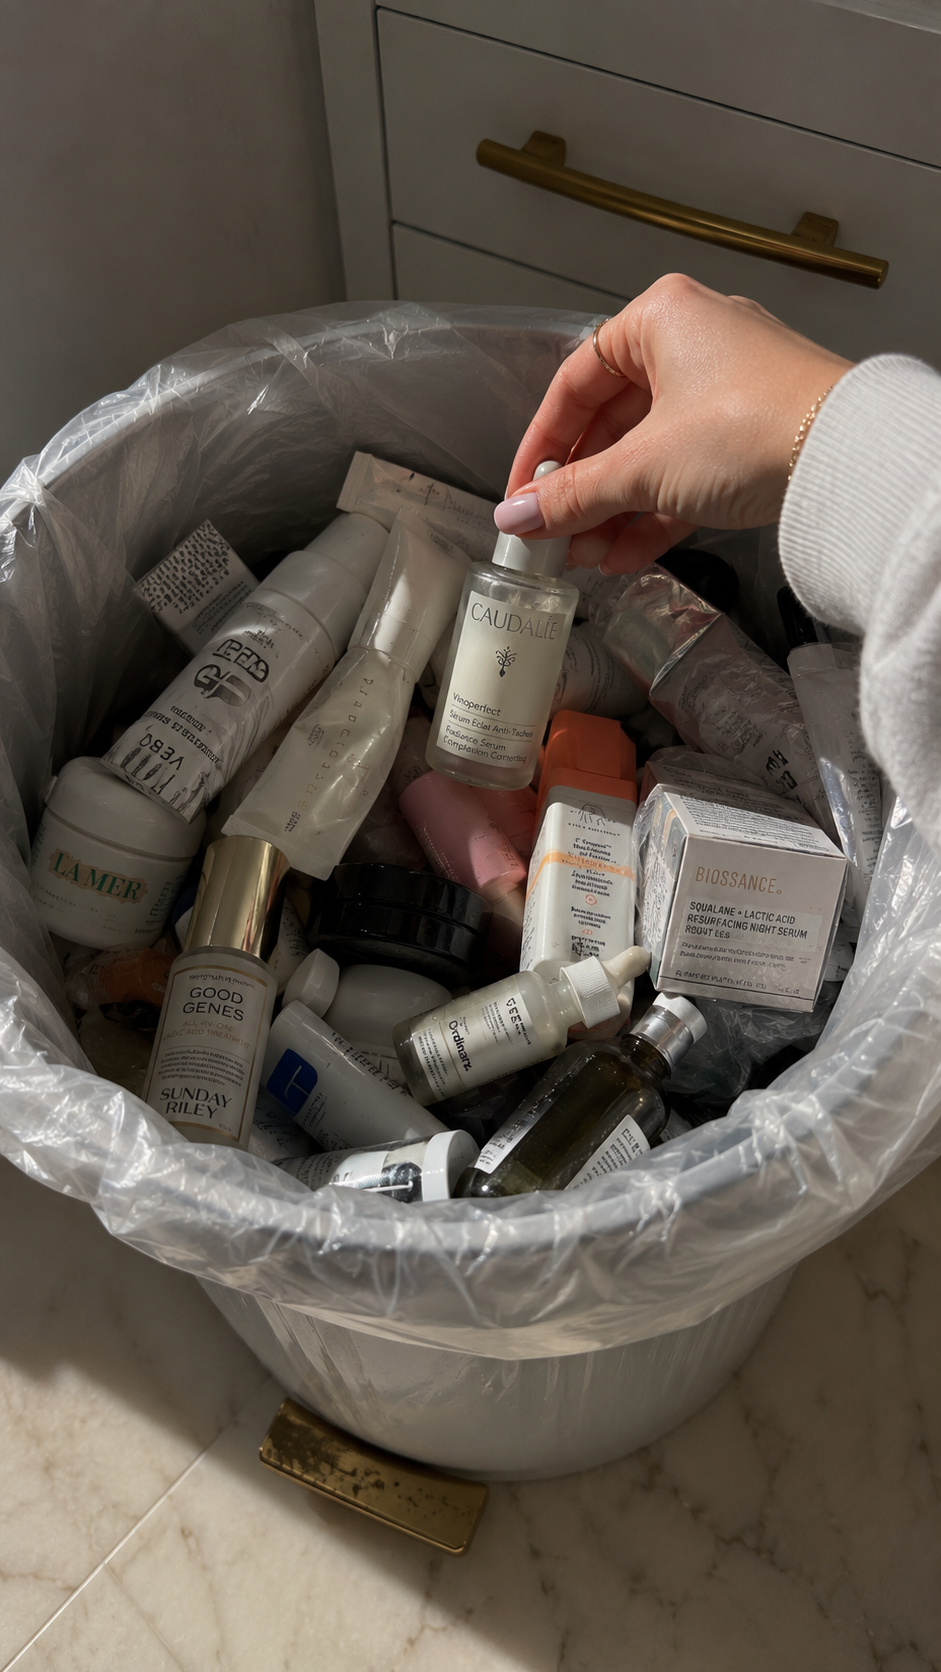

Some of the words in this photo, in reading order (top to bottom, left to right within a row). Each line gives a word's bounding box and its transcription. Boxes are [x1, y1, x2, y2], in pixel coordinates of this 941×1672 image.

[453, 692, 501, 717] Vinoperfect
[53, 852, 81, 882] LA
[84, 868, 142, 901] MER
[690, 901, 736, 917] SQUALANE
[744, 909, 775, 923] LACTIC
[776, 914, 796, 925] ACID
[749, 923, 776, 936] NIGHT
[777, 926, 808, 940] SERUM
[189, 987, 243, 1005] GOOD
[182, 1002, 244, 1021] GENES
[160, 1087, 232, 1109] SUNDAY
[165, 1101, 218, 1119] RILEY
